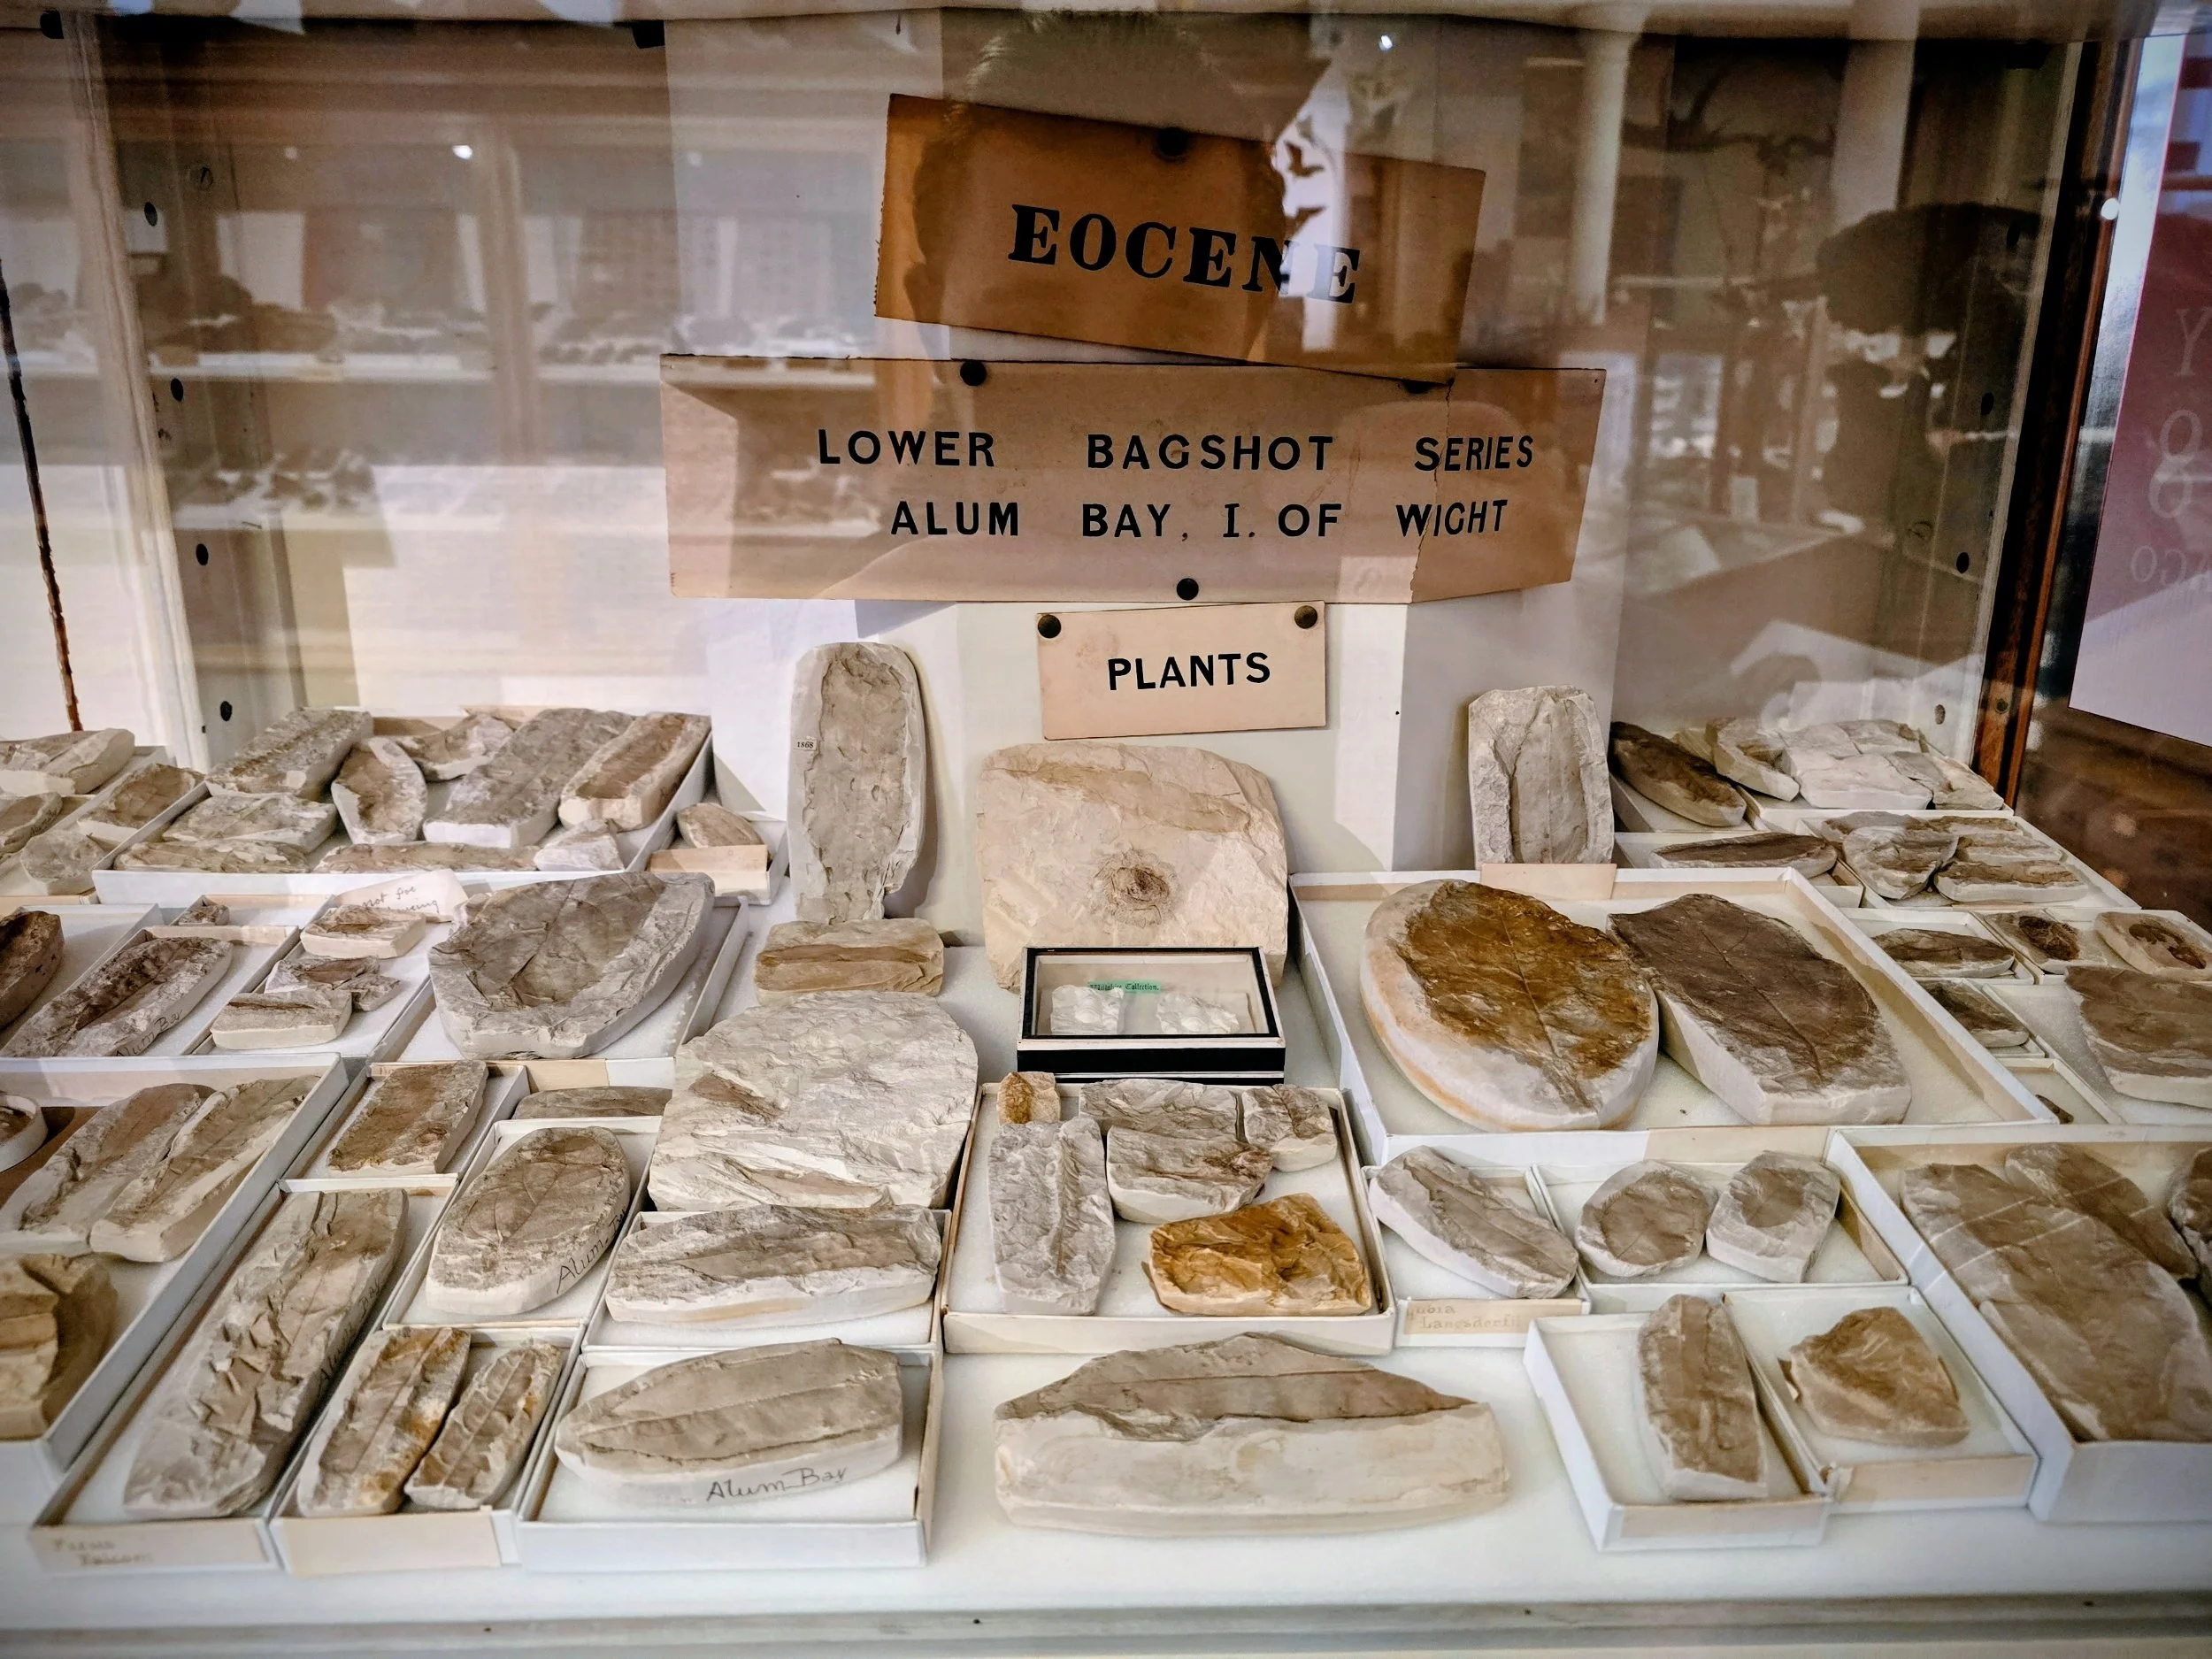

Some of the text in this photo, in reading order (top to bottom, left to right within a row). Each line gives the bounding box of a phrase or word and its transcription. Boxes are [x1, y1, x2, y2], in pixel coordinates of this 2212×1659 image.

[1008, 204, 1360, 303] EOCENE
[818, 429, 1534, 472] LOWER BAGSHOT SERIES
[891, 499, 1509, 541] ALUM BAY, I. OF WIGHT
[1108, 652, 1271, 690] PLANTS
[557, 1239, 604, 1294] Alum
[706, 1467, 847, 1502] Alum Bay
